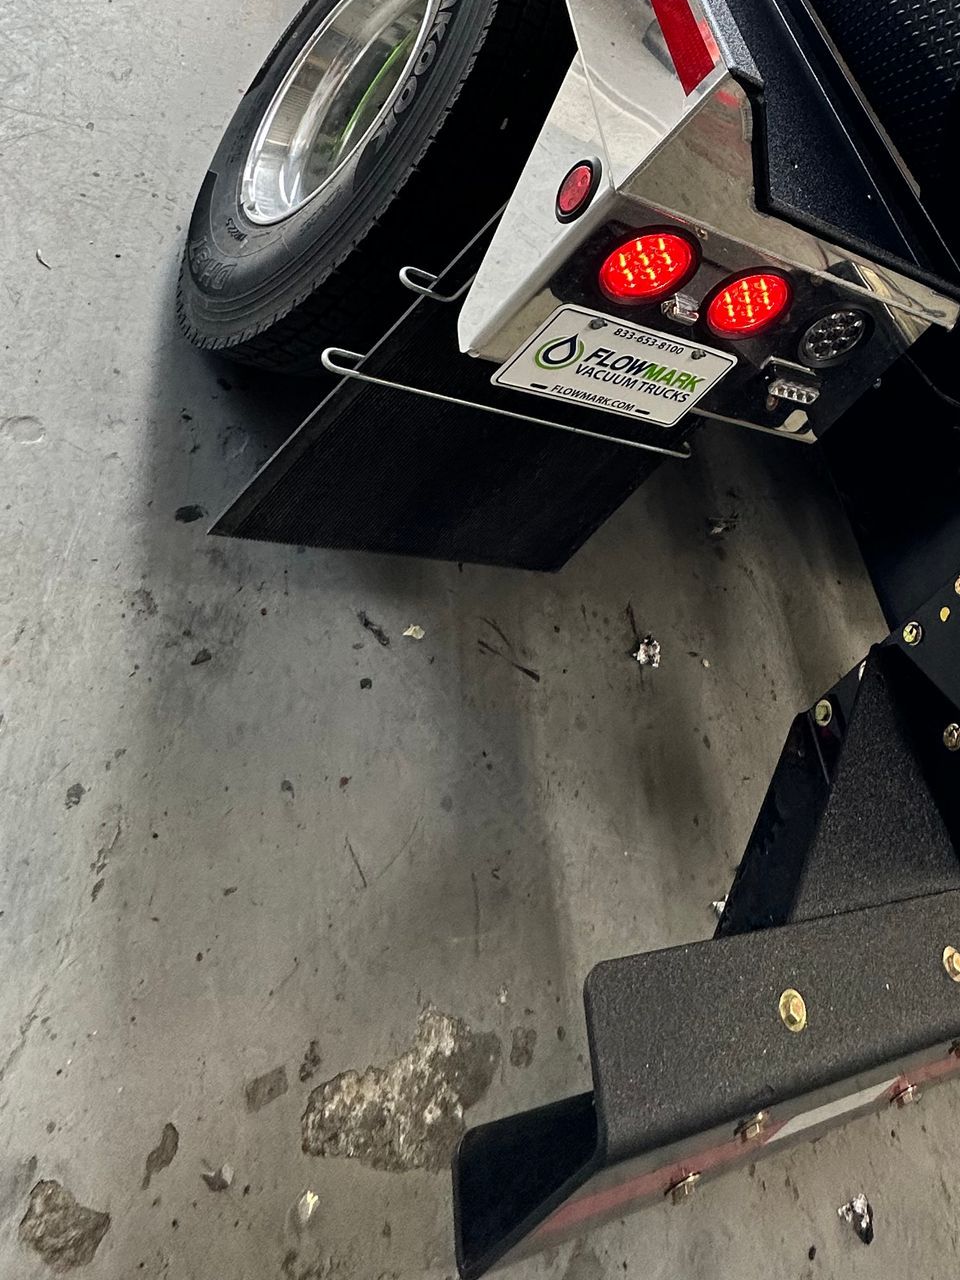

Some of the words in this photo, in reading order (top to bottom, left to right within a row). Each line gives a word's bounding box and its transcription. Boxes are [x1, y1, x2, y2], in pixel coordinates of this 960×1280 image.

[613, 327, 684, 355] 833-653-8100
[575, 363, 638, 390] VACUUM
[637, 380, 690, 404] TRUCKS
[583, 347, 706, 393] FLOWMARK
[551, 384, 636, 412] FLOWMARK.COM
